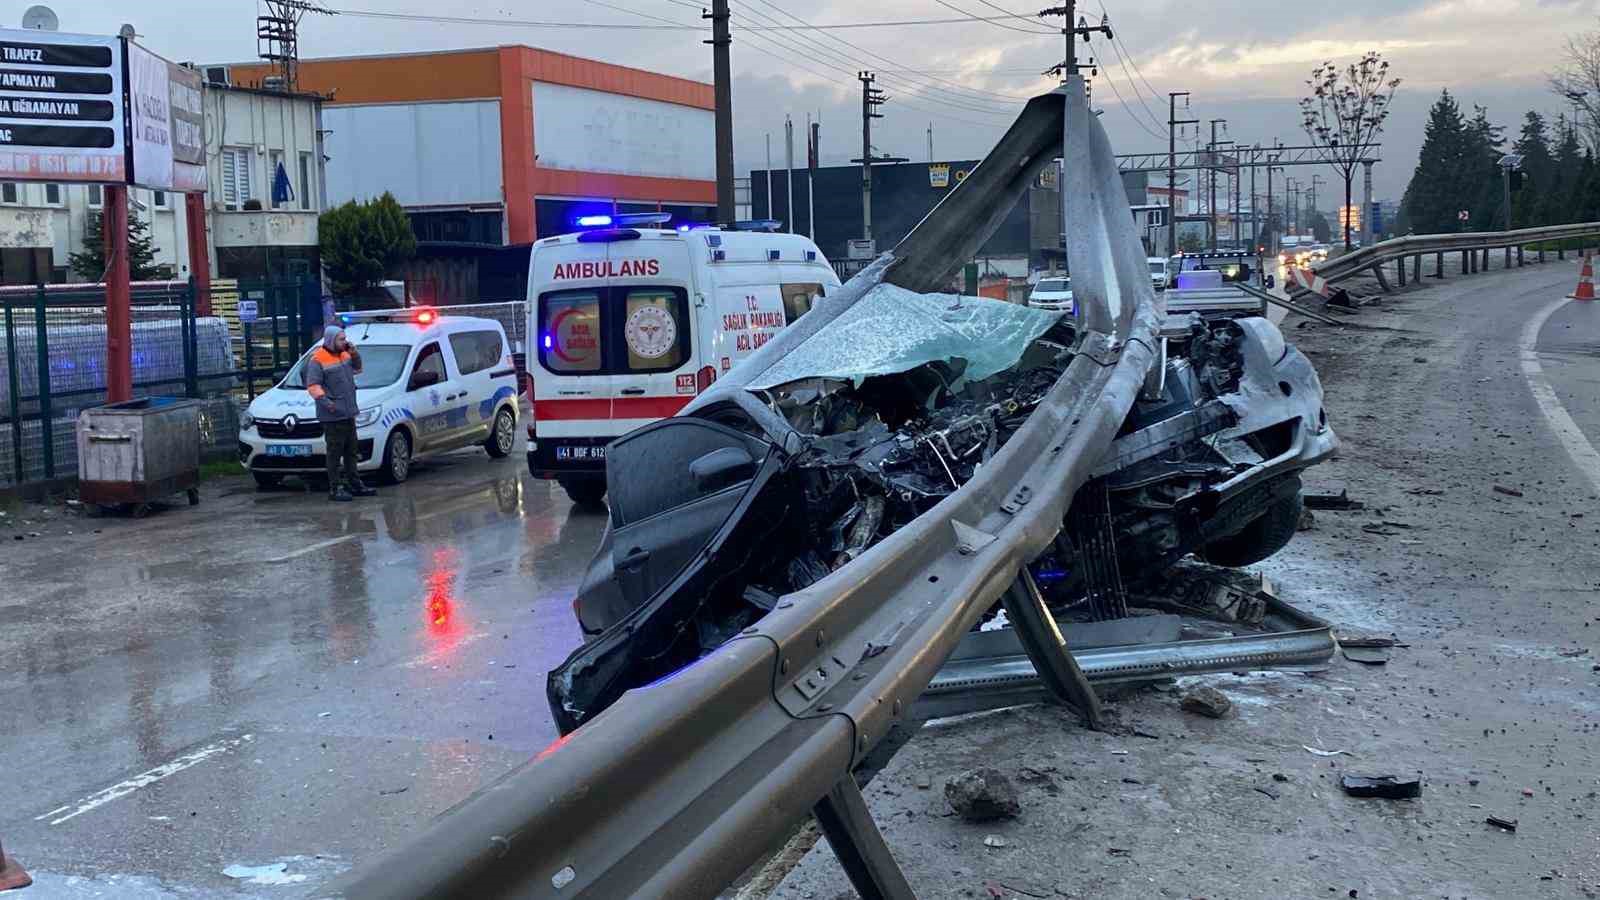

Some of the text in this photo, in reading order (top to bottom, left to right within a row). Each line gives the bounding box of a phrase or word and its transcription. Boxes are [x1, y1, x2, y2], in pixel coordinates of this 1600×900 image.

[3, 47, 42, 61] TRAPEZ
[12, 99, 78, 114] UĞRAMAYAN
[553, 259, 660, 280] AMBULANS
[678, 375, 693, 386] 112
[560, 447, 570, 457] 41
